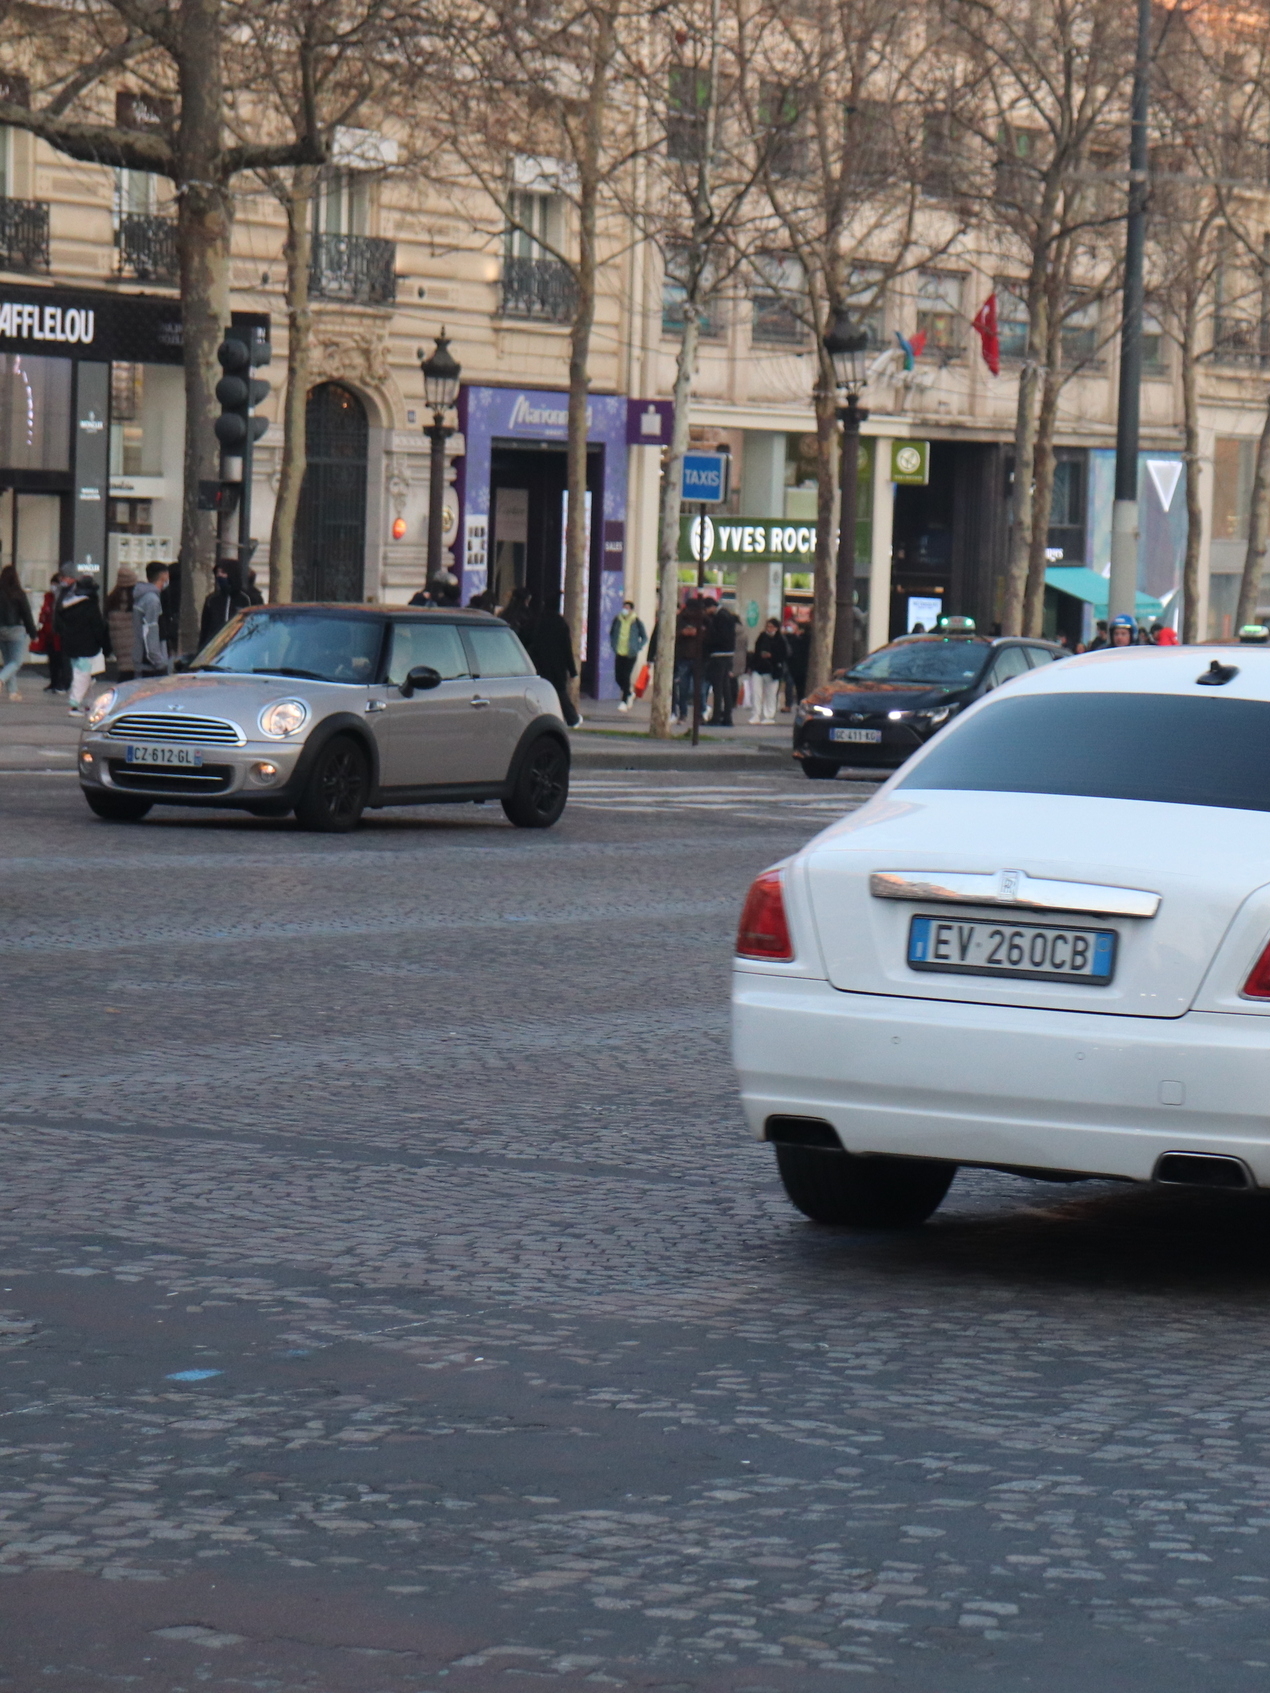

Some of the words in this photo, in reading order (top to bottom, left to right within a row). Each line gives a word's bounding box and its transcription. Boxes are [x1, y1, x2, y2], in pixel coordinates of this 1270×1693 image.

[0, 302, 95, 345] AFFLELOU
[508, 394, 593, 430] Marionnd
[684, 468, 720, 487] TAXIS
[718, 525, 765, 553] YVES
[770, 526, 840, 554] ROCH
[934, 923, 975, 962] EV
[986, 928, 1090, 971] 260CB
